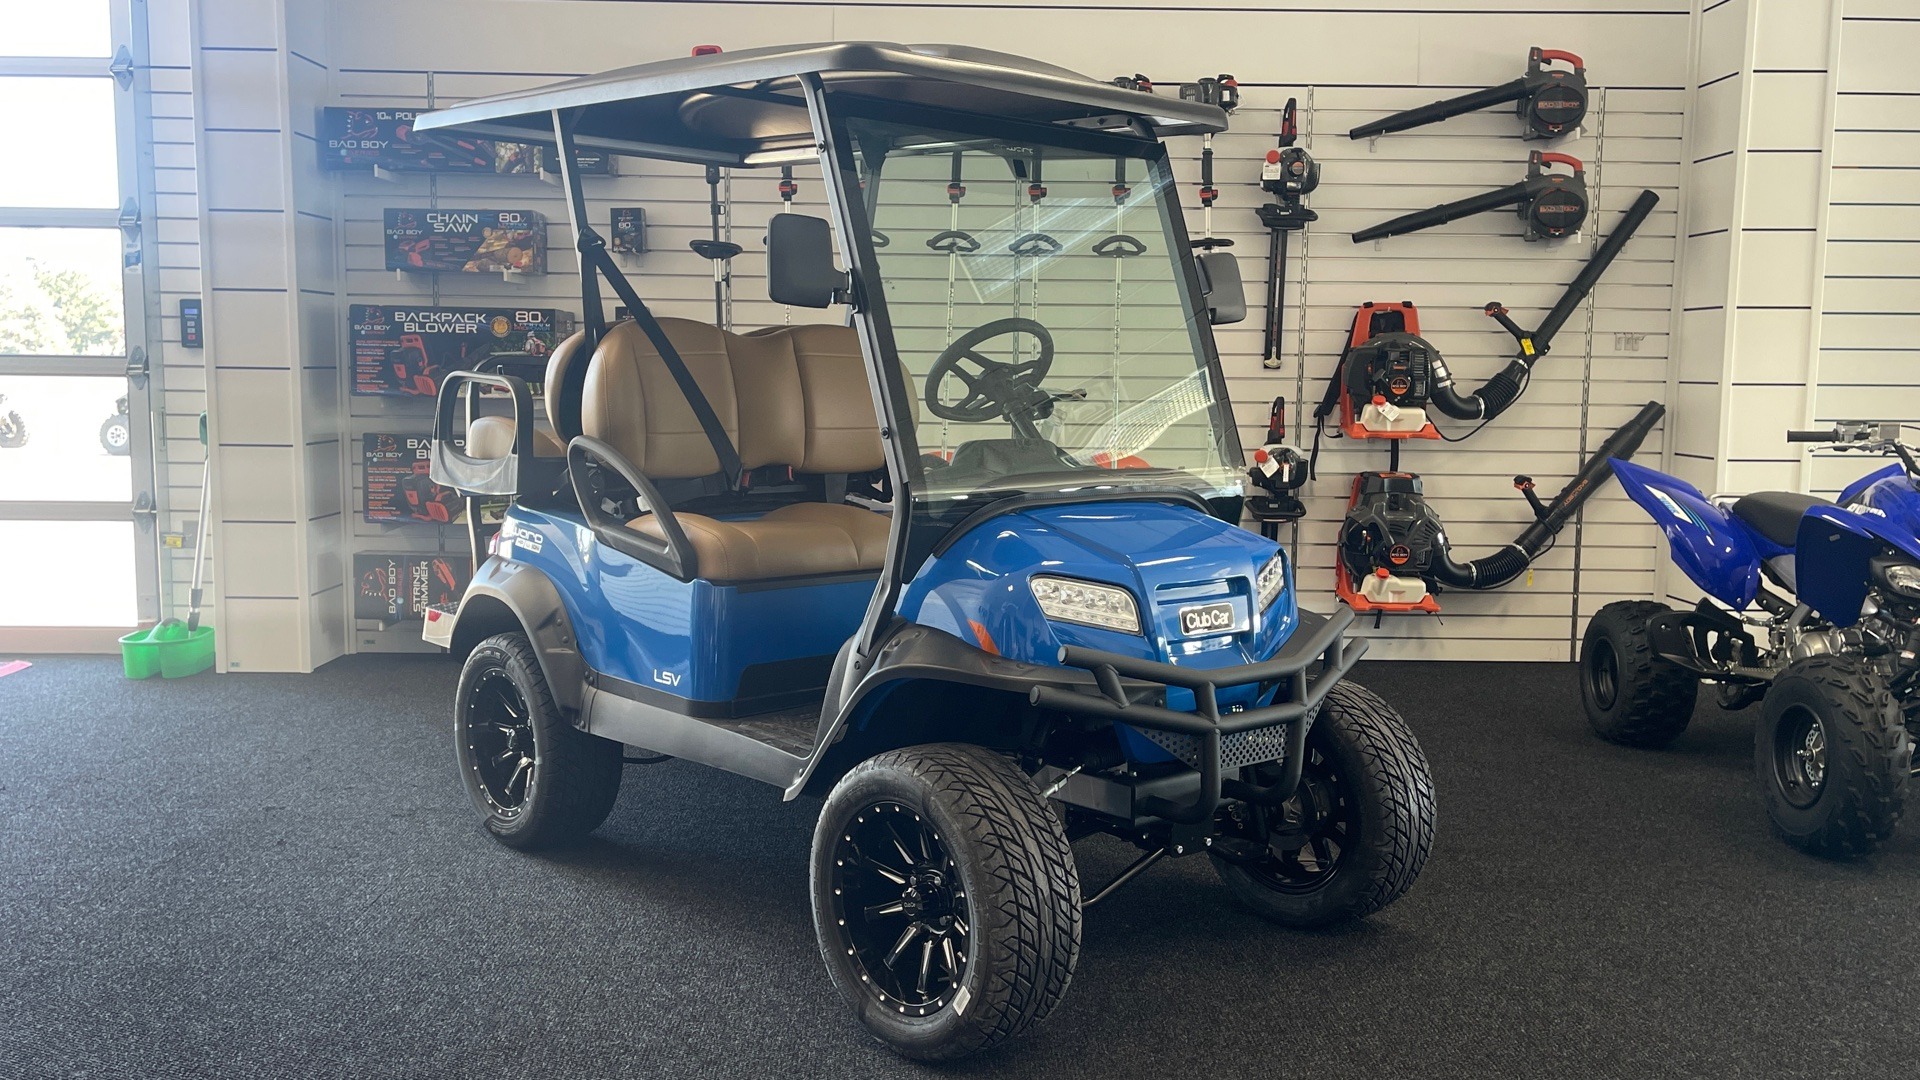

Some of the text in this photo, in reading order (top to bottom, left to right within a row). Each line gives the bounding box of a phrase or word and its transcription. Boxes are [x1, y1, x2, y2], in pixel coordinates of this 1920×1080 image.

[329, 140, 388, 149] BAD BOY
[426, 213, 479, 224] CHAIN
[433, 223, 473, 233] SAW
[394, 312, 487, 324] BACKPACK
[404, 322, 478, 334] BLOWER
[388, 559, 396, 614] BAD BOY
[412, 566, 421, 613] STRING
[420, 560, 429, 618] TRIMMER
[1186, 610, 1229, 628] Club Car
[653, 668, 681, 687] LSV
